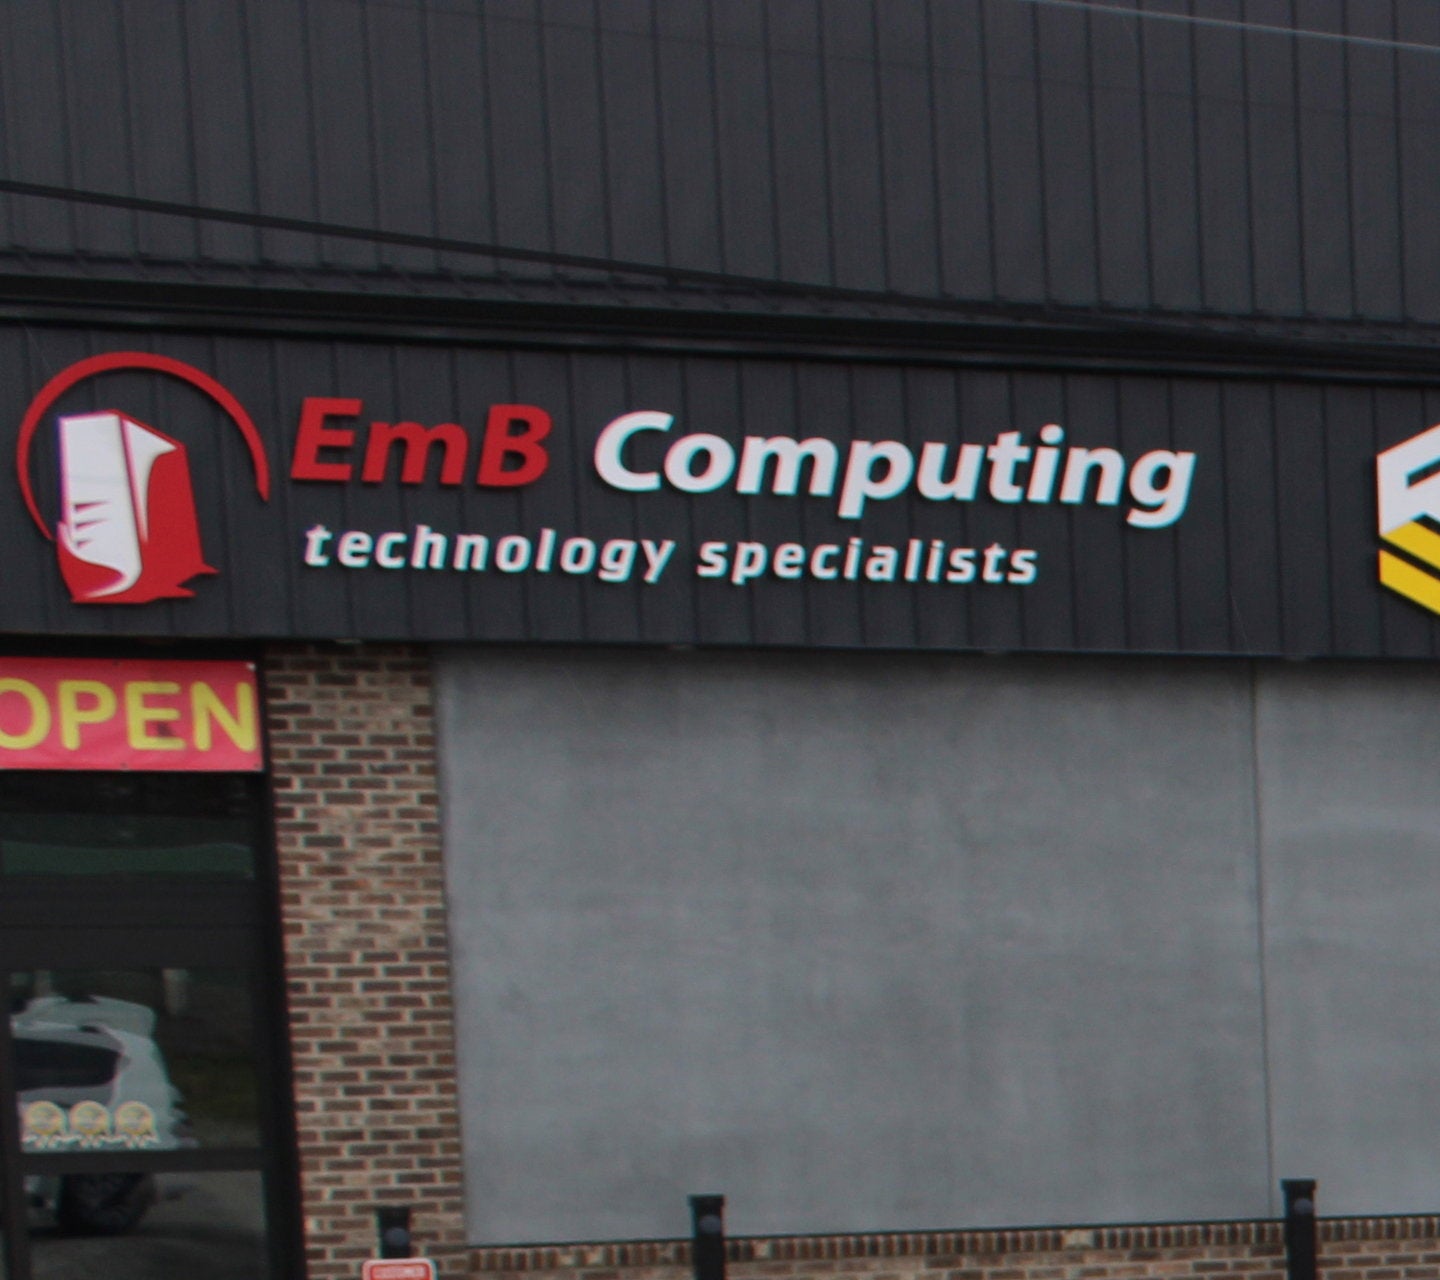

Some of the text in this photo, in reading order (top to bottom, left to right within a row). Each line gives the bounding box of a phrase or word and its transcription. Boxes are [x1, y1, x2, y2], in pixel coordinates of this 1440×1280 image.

[289, 397, 1198, 528] EmB Computing
[303, 523, 1039, 586] technology specialists
[0, 677, 257, 752] OPEN
